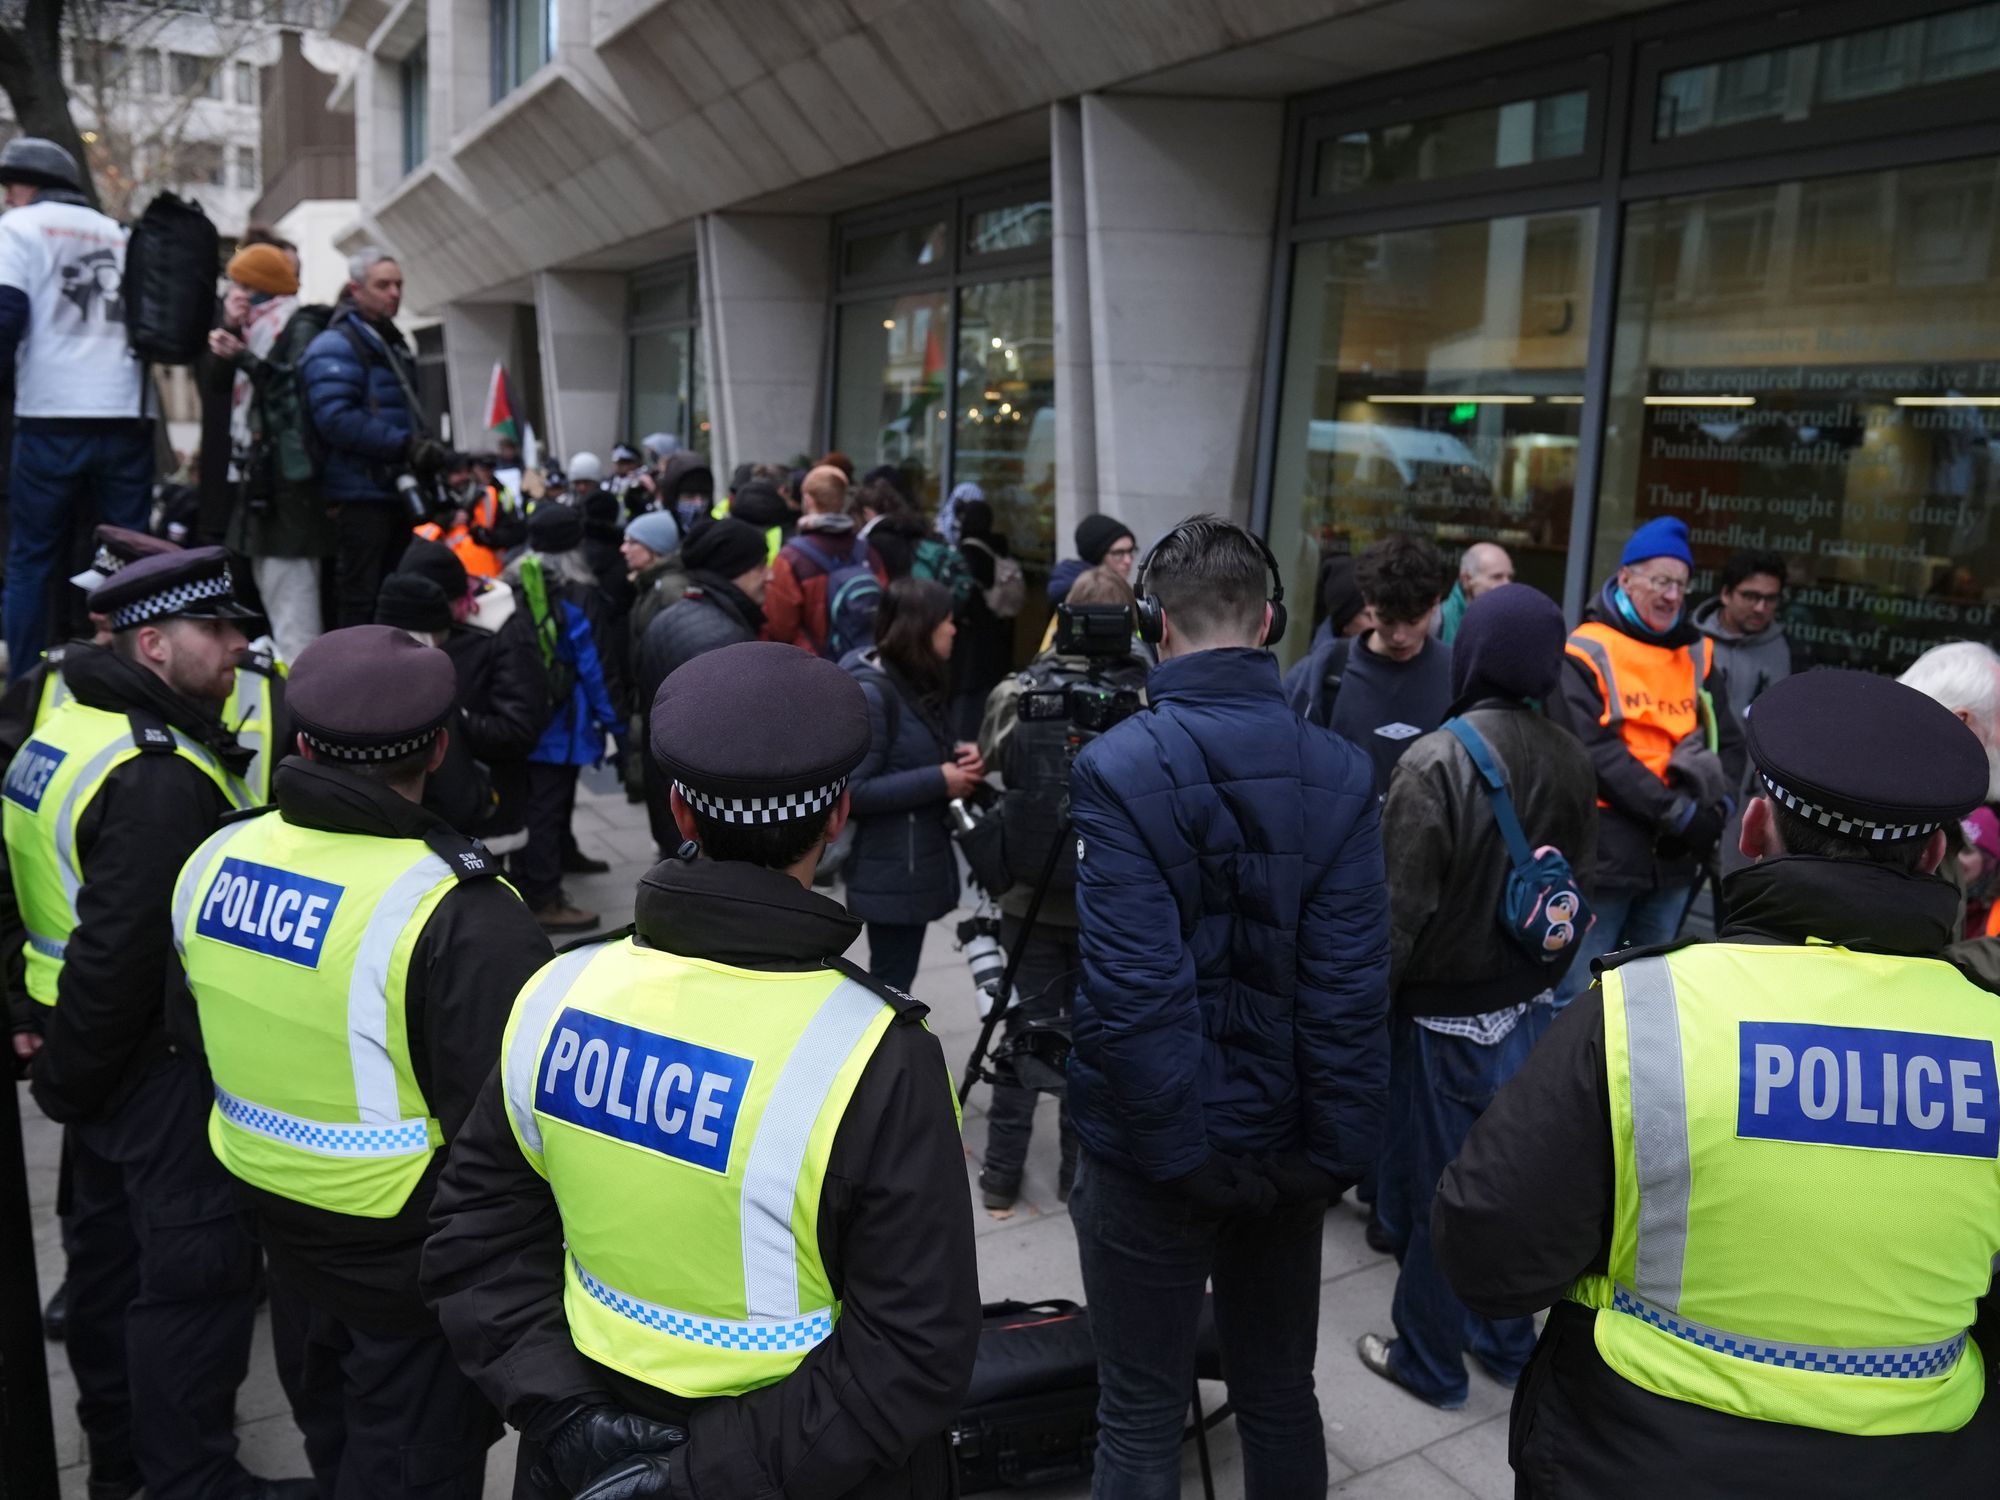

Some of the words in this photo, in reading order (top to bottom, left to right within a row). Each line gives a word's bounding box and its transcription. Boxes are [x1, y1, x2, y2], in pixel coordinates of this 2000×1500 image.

[1684, 367, 1707, 390] be
[1712, 366, 1803, 396] required
[1809, 373, 1851, 390] nor
[1856, 365, 1969, 389] excessive
[1976, 363, 2000, 388] Fi
[1785, 402, 1852, 427] cruell
[1650, 437, 1786, 462] Punishments
[1646, 482, 1694, 508] That
[1695, 486, 1763, 515] Jurors
[1767, 491, 1836, 524] ought
[1841, 498, 1867, 521] to
[1873, 498, 1901, 522] be
[1908, 499, 1981, 533] duely
[1689, 524, 1766, 550] nnelled
[1771, 530, 1813, 555] and
[1795, 584, 1841, 608] and
[1846, 588, 1958, 622] Promises
[1964, 601, 1997, 625] of
[1786, 616, 1853, 645] itures
[1857, 626, 1888, 650] of
[459, 852, 477, 861] SW
[202, 871, 330, 950] POLICE
[544, 1027, 732, 1148] POLICE
[1753, 1043, 1986, 1134] POLICE
